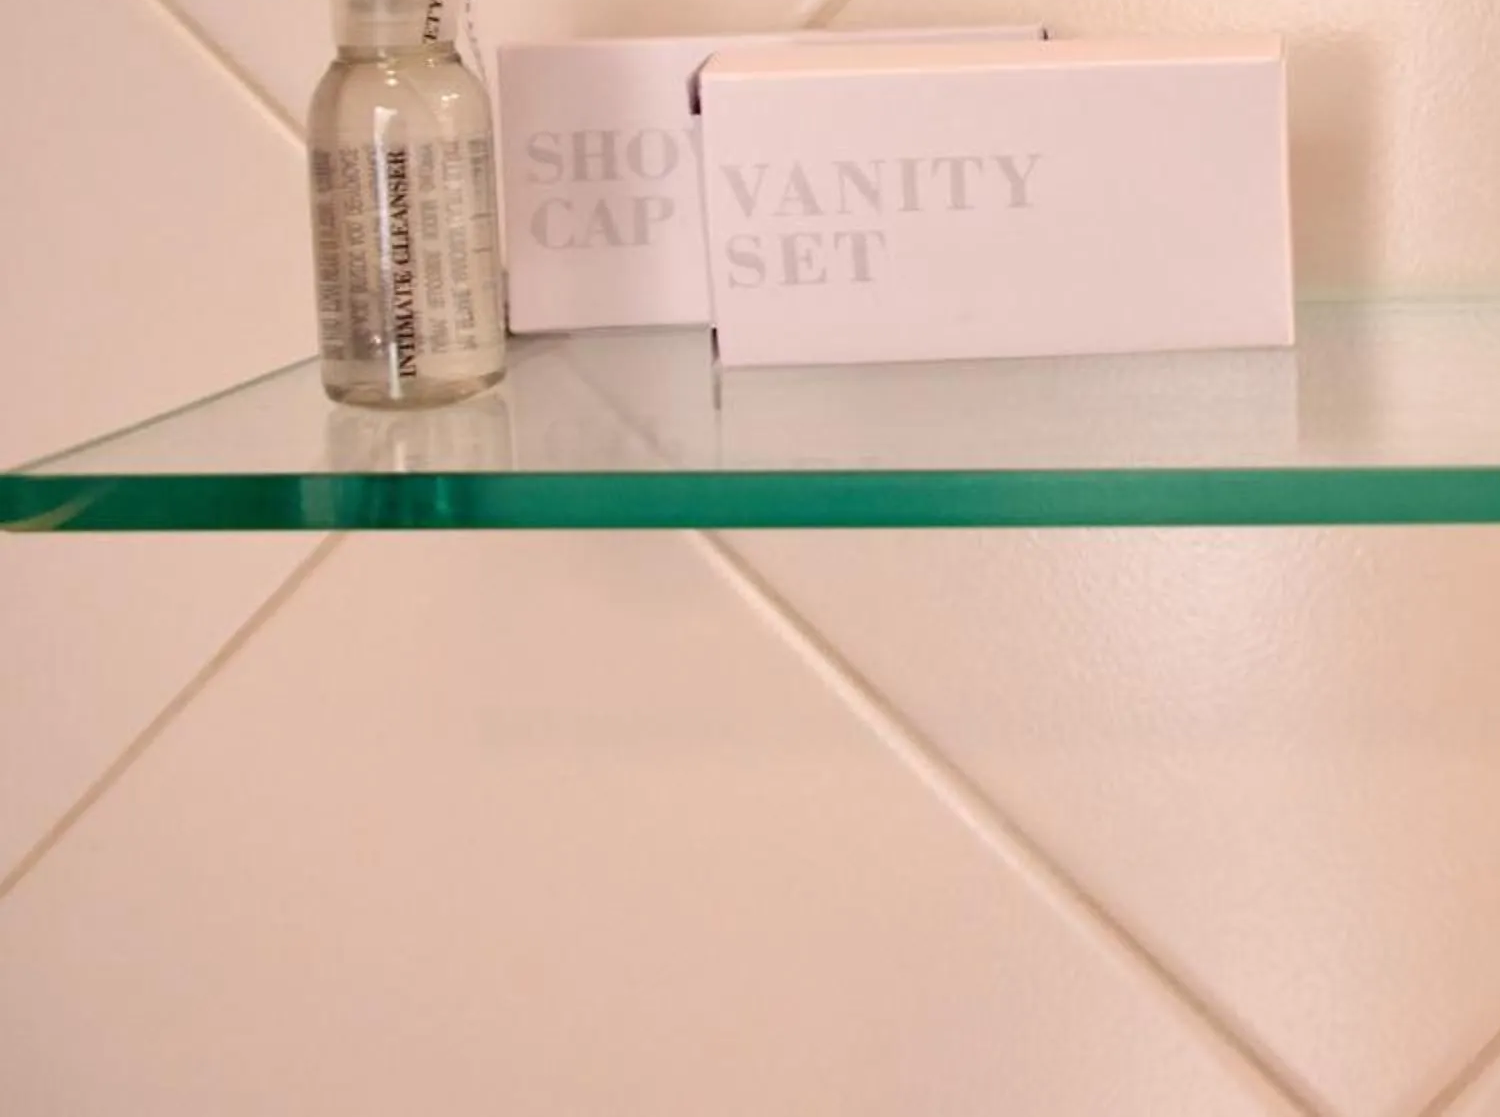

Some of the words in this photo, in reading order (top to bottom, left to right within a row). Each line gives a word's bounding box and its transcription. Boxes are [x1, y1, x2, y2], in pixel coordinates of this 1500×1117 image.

[526, 128, 704, 184] SHO
[721, 153, 1044, 219] VANITY
[386, 151, 411, 266] CLEANSER
[529, 197, 676, 251] CAP
[726, 230, 888, 289] SET
[393, 270, 417, 379] INTIMATE
